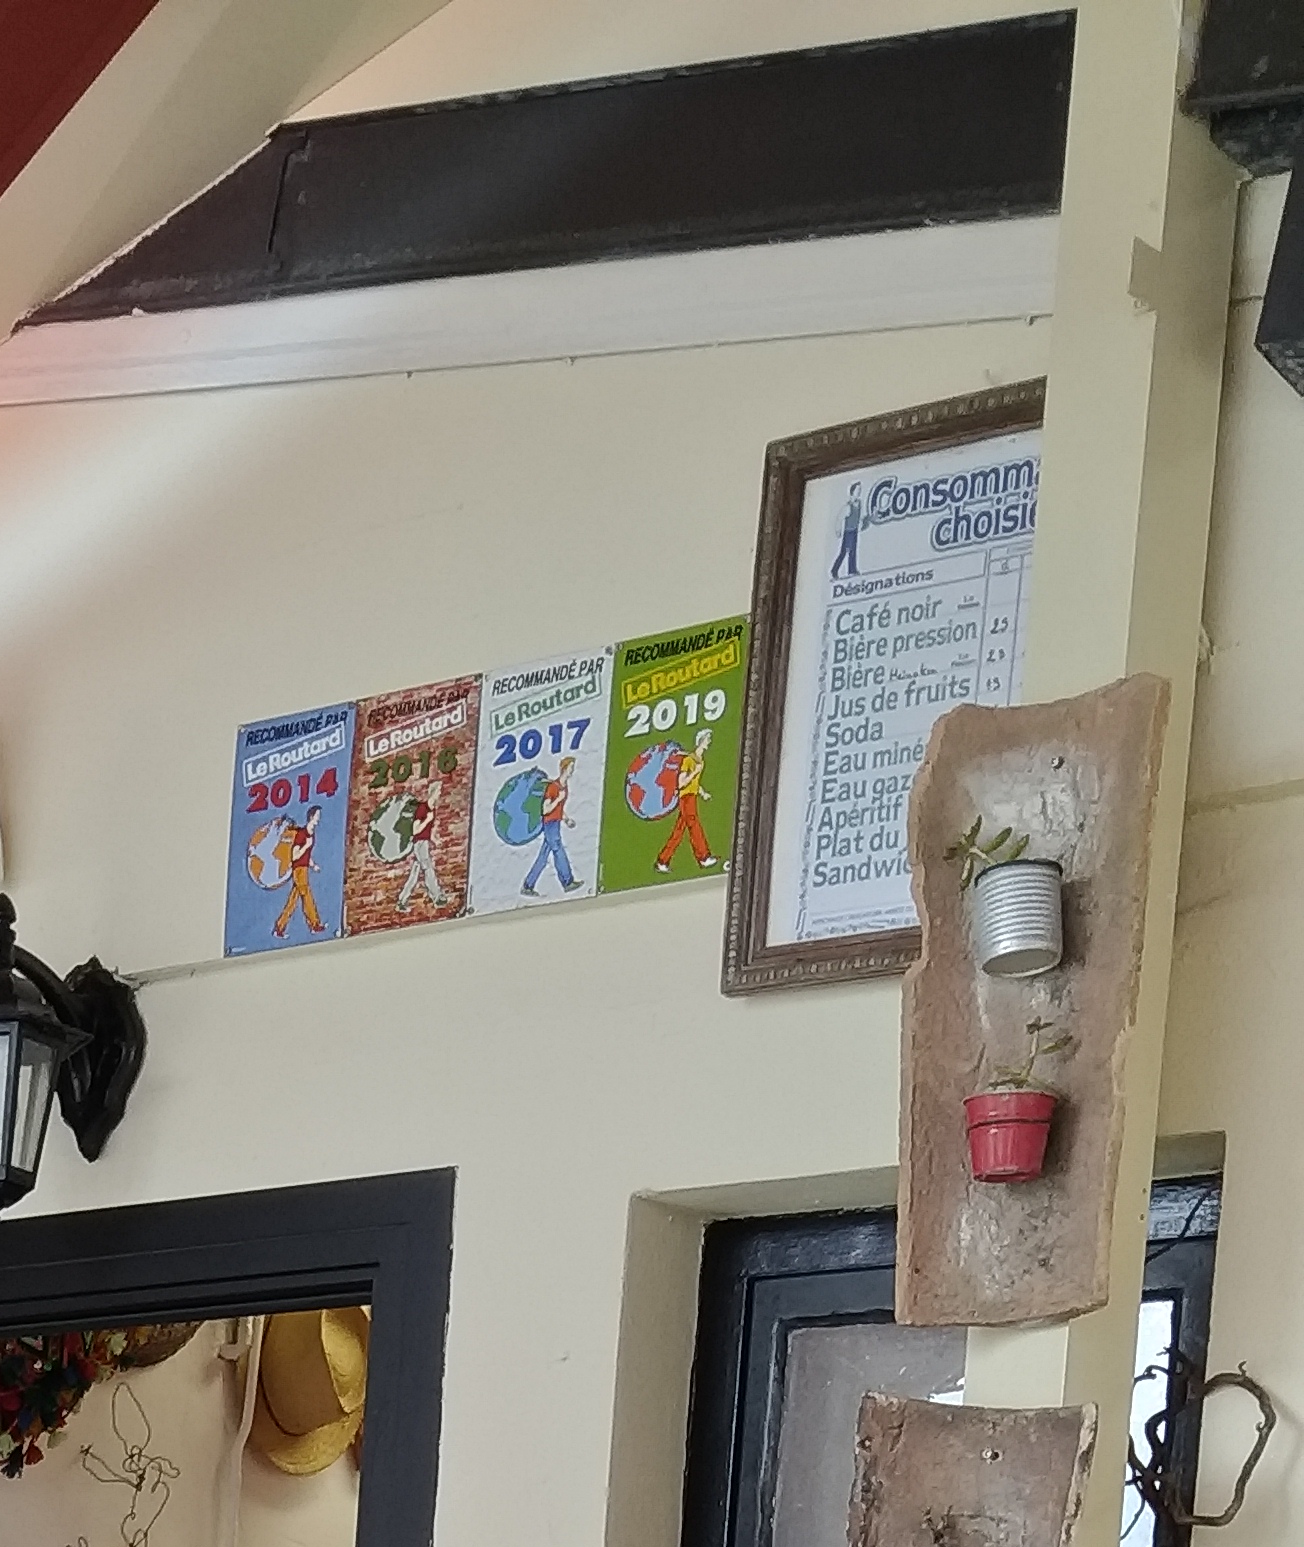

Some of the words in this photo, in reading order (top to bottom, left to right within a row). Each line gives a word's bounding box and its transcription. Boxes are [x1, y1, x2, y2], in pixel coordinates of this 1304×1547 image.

[871, 459, 1040, 519] Consomm
[833, 570, 933, 598] Désignations
[836, 601, 891, 636] Café
[898, 595, 943, 625] noir
[625, 628, 714, 666] RECOMMANDÉ
[716, 624, 744, 643] PAR
[833, 634, 888, 665] Bière
[893, 620, 977, 660] pression
[492, 661, 576, 697] RECOMMANDÉ
[579, 656, 605, 676] PAR
[831, 663, 885, 693] Bière
[367, 693, 447, 727] RECOMMANDÉ
[446, 688, 470, 705] PAR
[624, 688, 727, 738] 2019
[827, 694, 866, 721] Jus
[872, 686, 898, 712] de
[904, 675, 971, 706] fruits
[245, 712, 323, 747] RECOMMANDÉ
[323, 711, 348, 731] PAR
[493, 718, 591, 767] 2017
[825, 717, 884, 748] Soda
[368, 747, 459, 789] 2016
[823, 749, 867, 776] Eau
[246, 767, 338, 813] 2014
[821, 778, 867, 804] Eau
[872, 774, 911, 804] gaz
[817, 794, 902, 832] Apéritif
[816, 829, 864, 860] Plat
[869, 825, 900, 853] du
